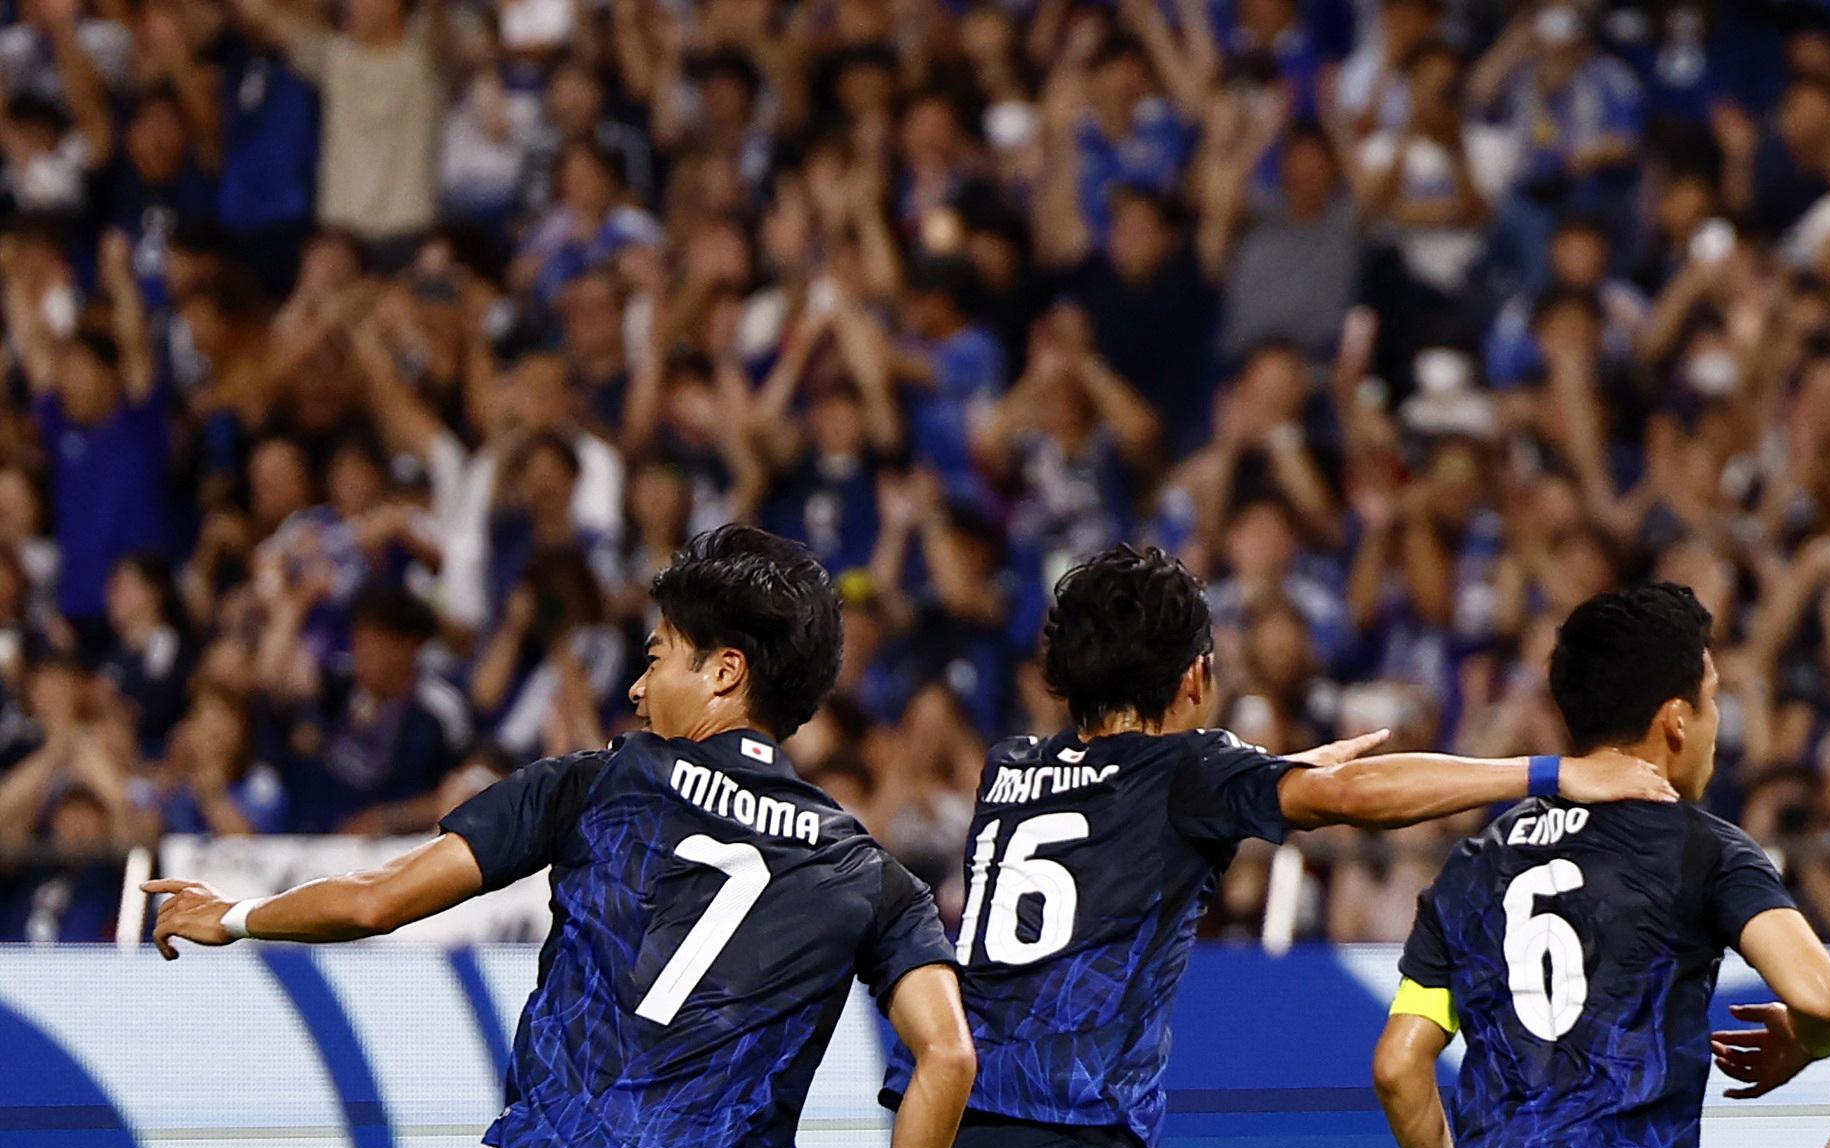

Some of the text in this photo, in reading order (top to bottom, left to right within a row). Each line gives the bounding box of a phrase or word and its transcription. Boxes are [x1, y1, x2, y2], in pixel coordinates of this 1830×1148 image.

[669, 758, 820, 846] MITOMA
[634, 833, 772, 1027] 7
[955, 811, 1090, 967] 16
[1502, 857, 1588, 1042] 6
